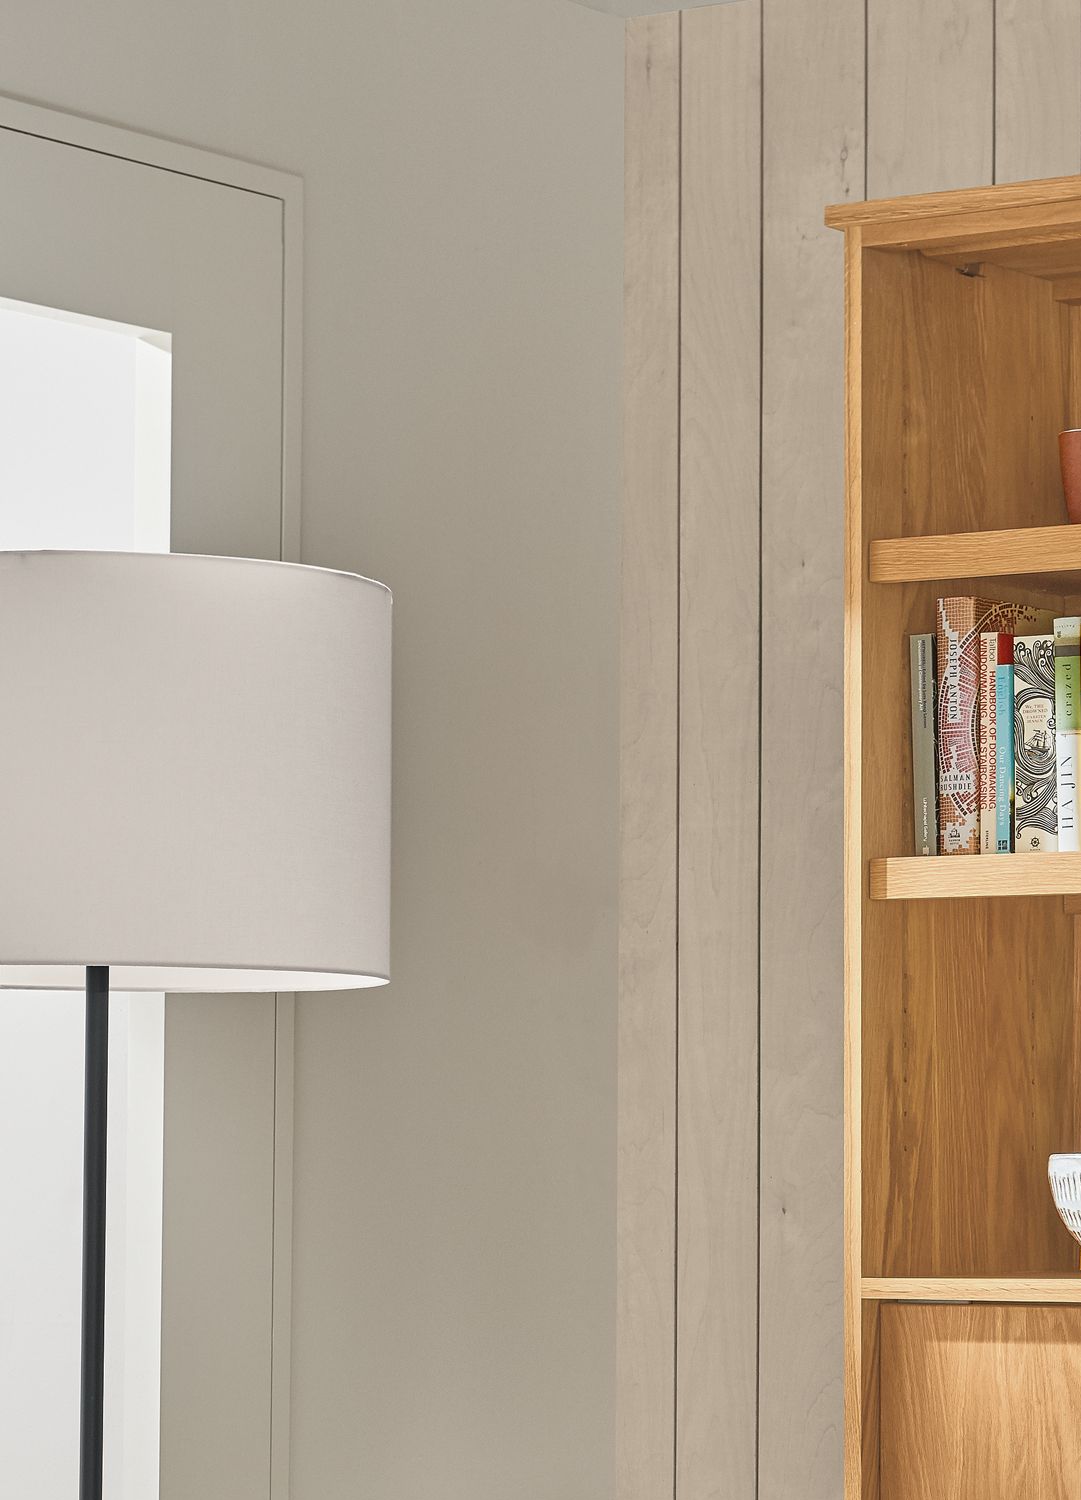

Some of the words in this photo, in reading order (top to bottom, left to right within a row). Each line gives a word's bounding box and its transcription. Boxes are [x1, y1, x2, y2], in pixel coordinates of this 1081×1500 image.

[949, 639, 958, 678] JOSEPH
[980, 639, 988, 721] WINDOWMAKING,
[997, 677, 1008, 715] English
[1062, 664, 1073, 717] crazed
[949, 684, 958, 720] ANTON
[989, 671, 997, 726] HANDBOOK
[980, 725, 988, 744] AND
[989, 728, 997, 741] OF
[998, 747, 1007, 764] Our
[1060, 756, 1076, 789] JIN
[940, 773, 971, 782] SALMAN
[940, 782, 972, 791] RUSHDIE
[980, 747, 988, 809] STAIRCASING
[988, 743, 997, 811] DOORMAKING,
[997, 767, 1007, 802] Dancing
[997, 805, 1006, 826] Days
[1061, 800, 1074, 830] HA
